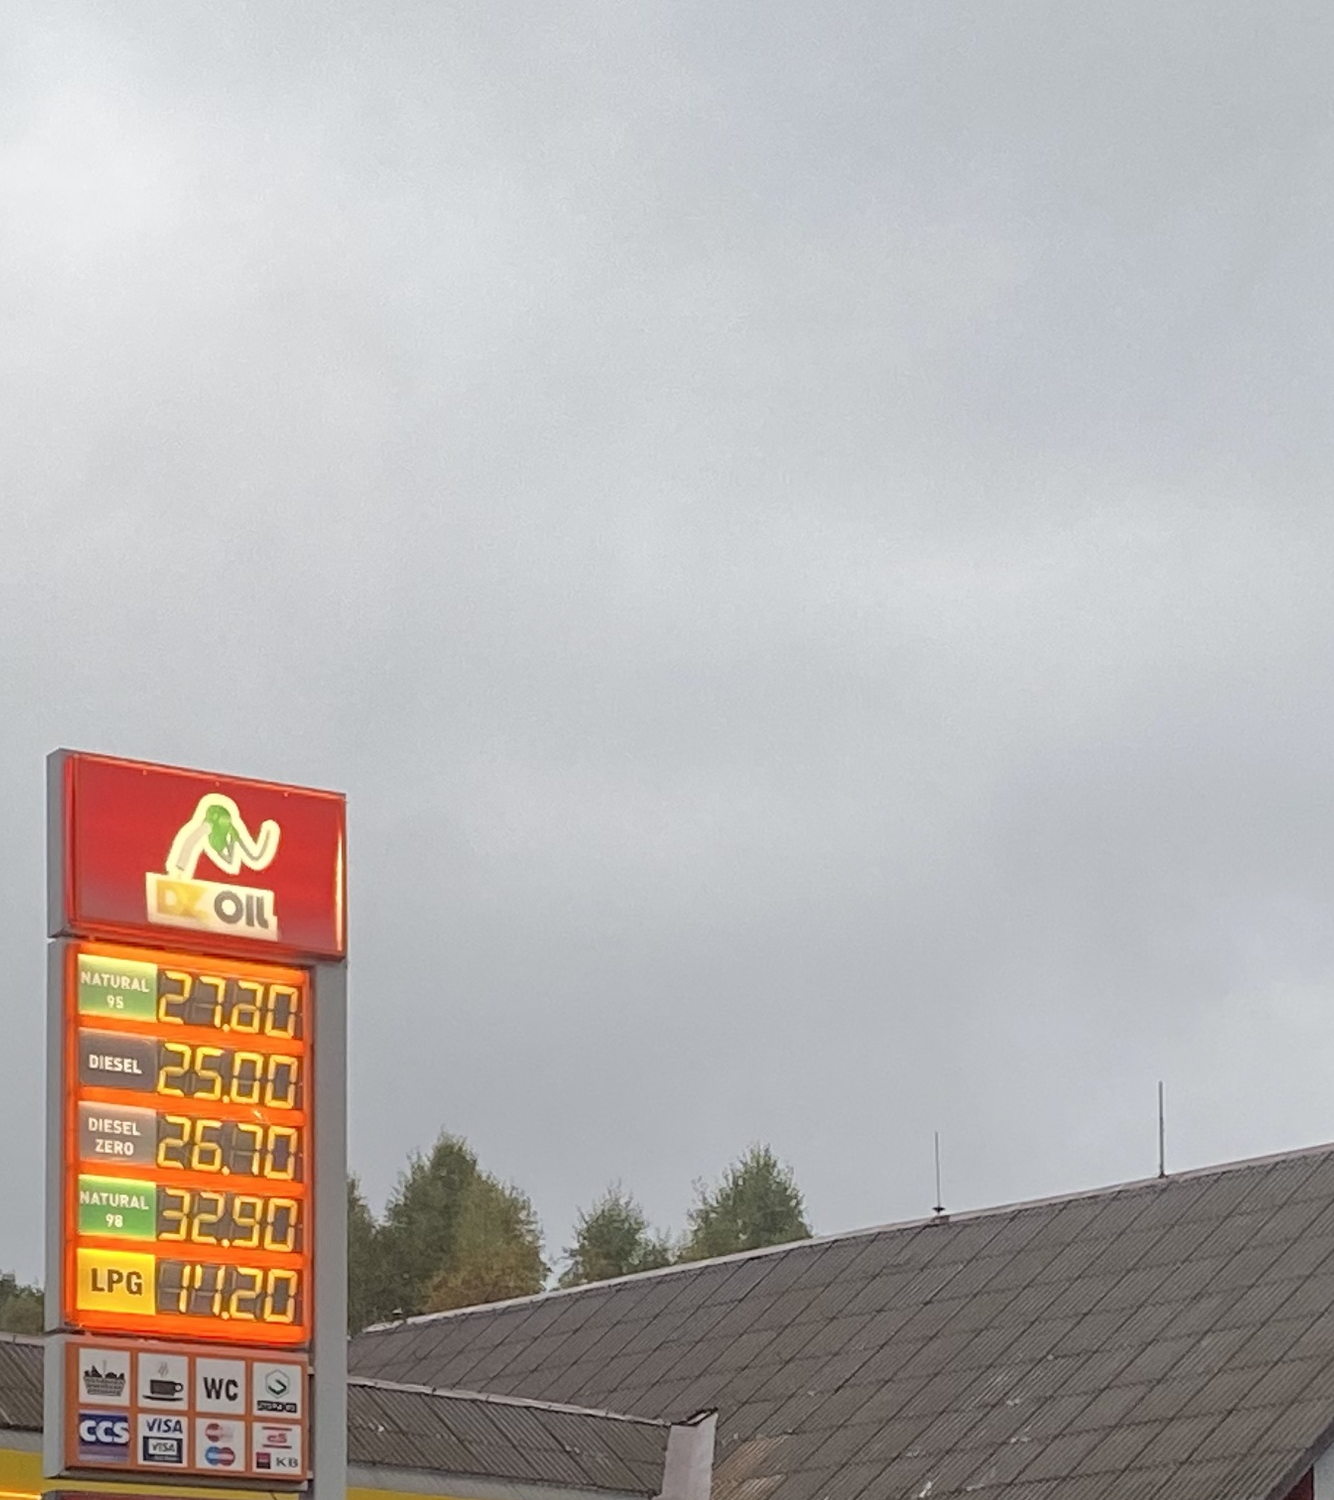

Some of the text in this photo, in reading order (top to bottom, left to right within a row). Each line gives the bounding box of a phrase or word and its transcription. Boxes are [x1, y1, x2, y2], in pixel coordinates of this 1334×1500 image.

[80, 971, 150, 992] NATURAL
[107, 995, 124, 1009] 95
[88, 1042, 299, 1109] DIESEL 25.00
[88, 1114, 298, 1181] DIESEL 26.70
[95, 1138, 134, 1156] ZERO
[79, 1187, 298, 1252] NATURAL 32.90
[105, 1213, 123, 1228] 98
[91, 1267, 144, 1296] LPG
[203, 1377, 238, 1401] WC
[79, 1419, 130, 1444] CCS
[146, 1418, 183, 1434] VISA
[276, 1456, 298, 1468] KB
